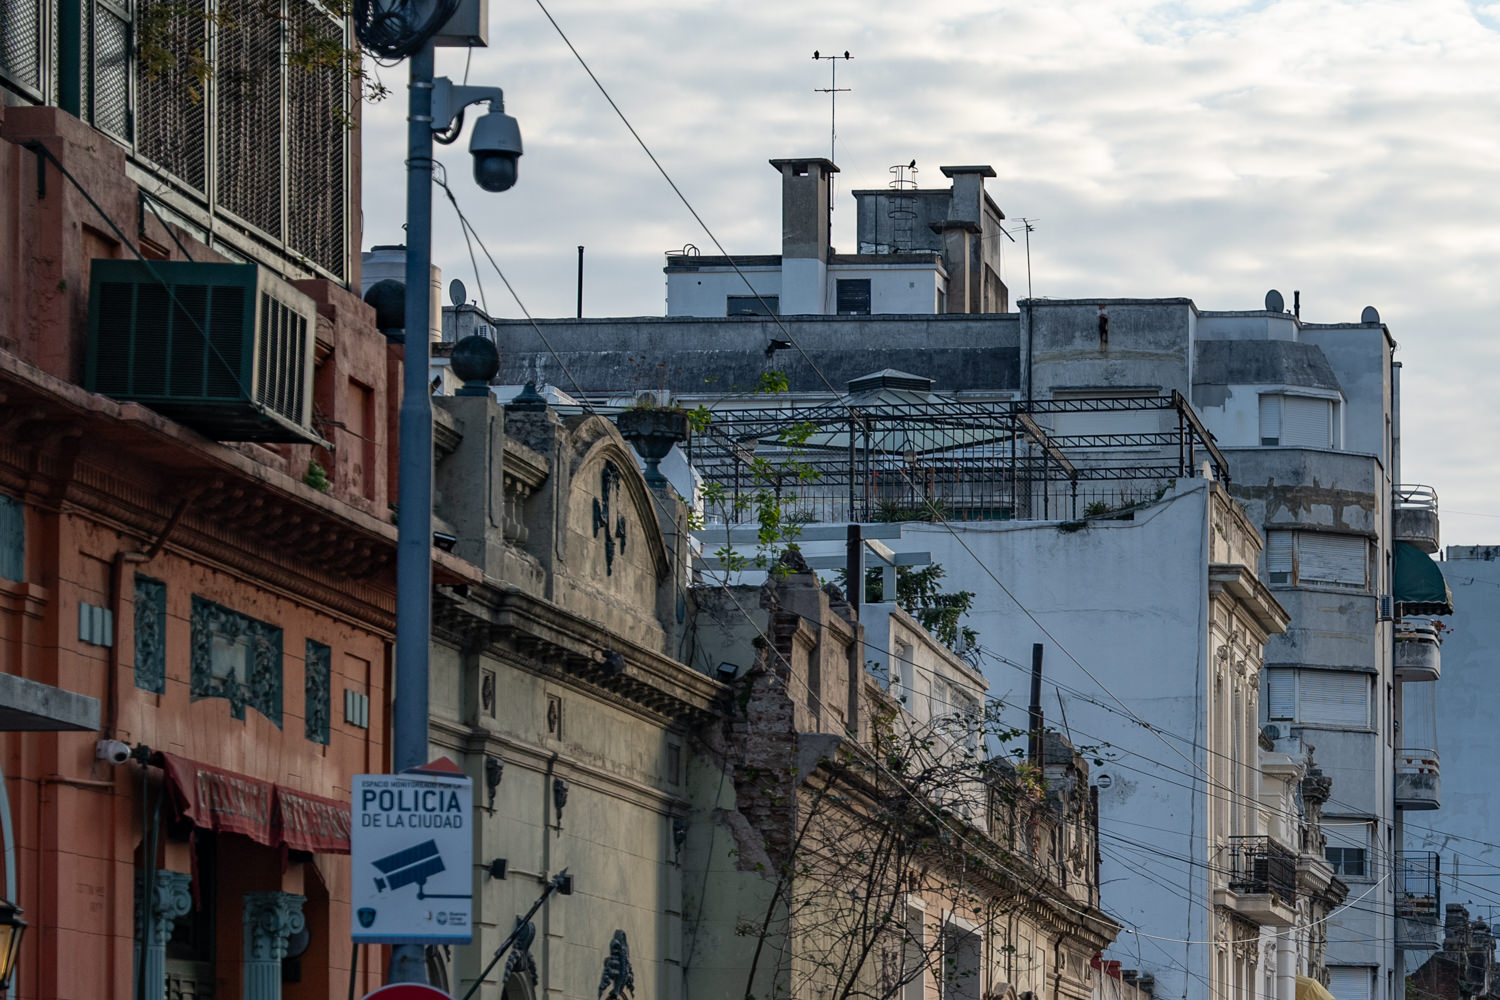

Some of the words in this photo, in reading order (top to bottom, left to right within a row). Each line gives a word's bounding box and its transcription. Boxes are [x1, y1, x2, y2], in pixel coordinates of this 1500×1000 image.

[362, 789, 461, 812] POLICIA
[361, 813, 381, 828] DE
[386, 814, 404, 828] LA
[408, 814, 462, 829] CIUDAD
